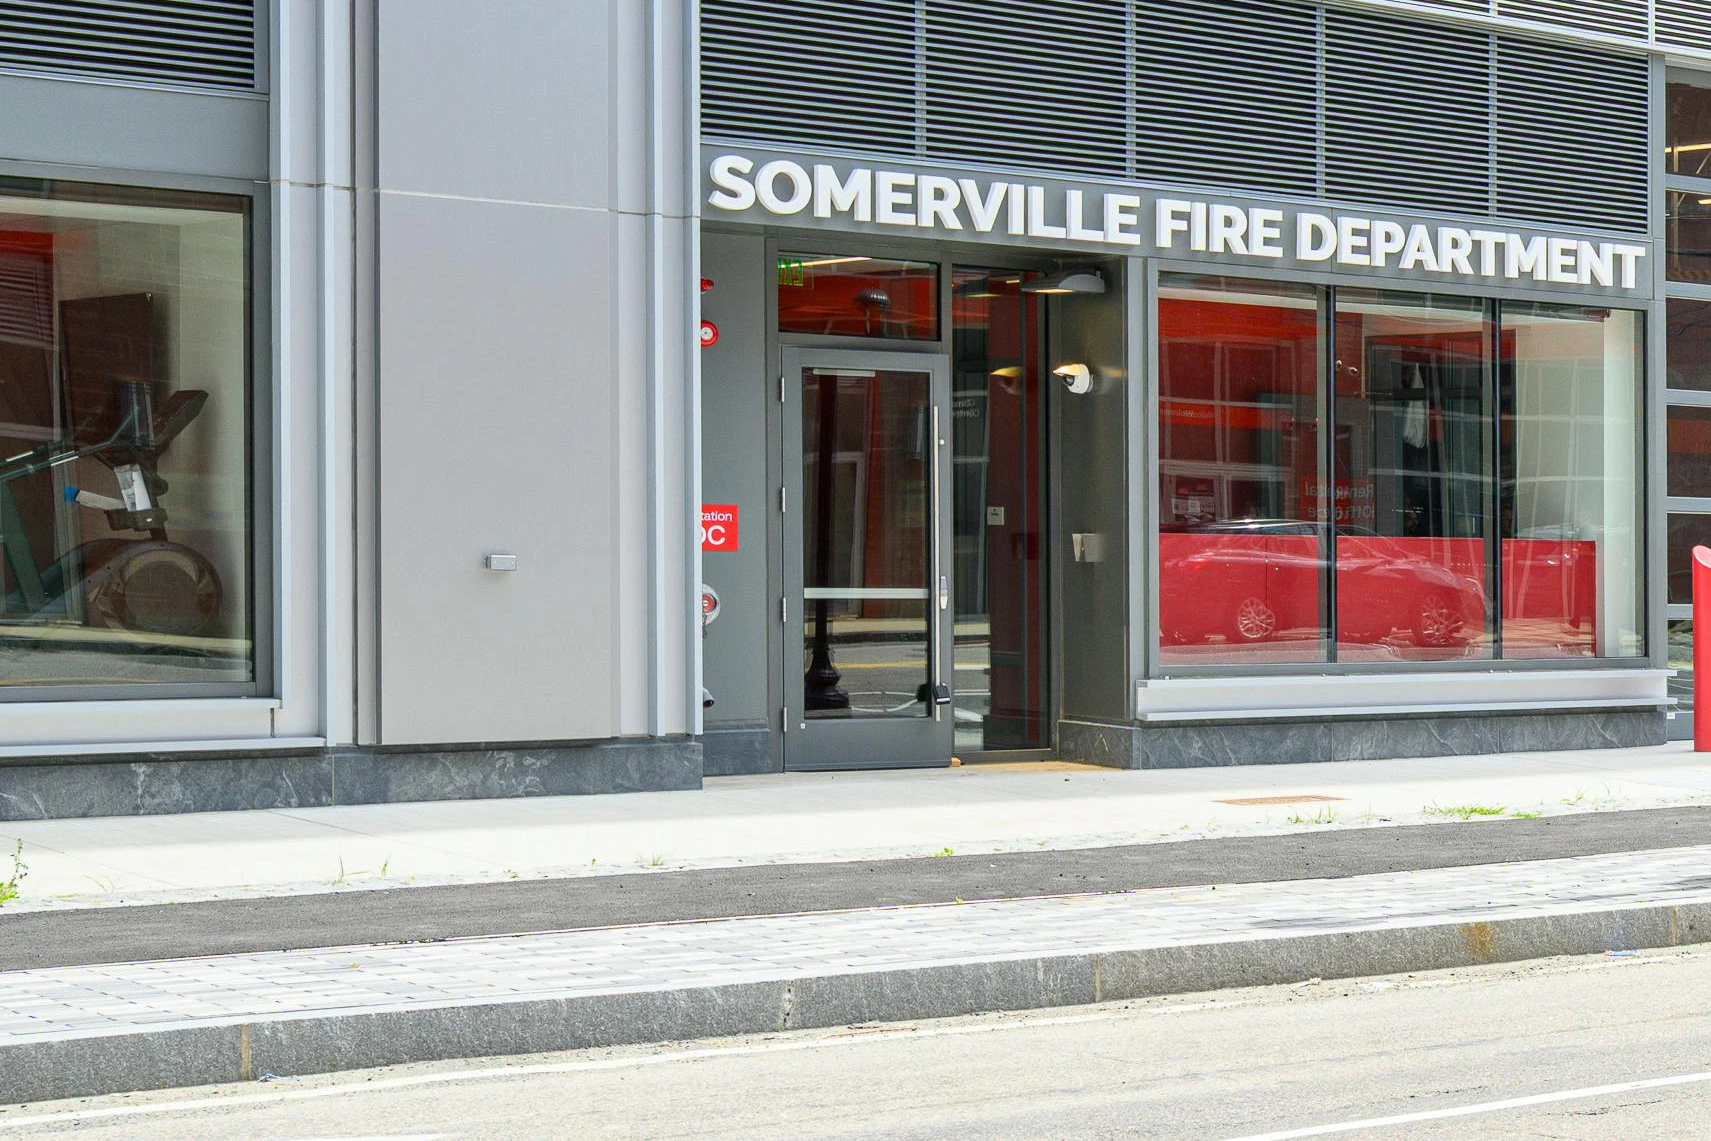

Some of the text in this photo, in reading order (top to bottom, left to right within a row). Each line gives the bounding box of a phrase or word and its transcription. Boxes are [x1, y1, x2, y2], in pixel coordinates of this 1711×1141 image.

[708, 155, 1646, 289] SOMERVILLE FIRE DEPARTMENT
[702, 511, 733, 522] ation
